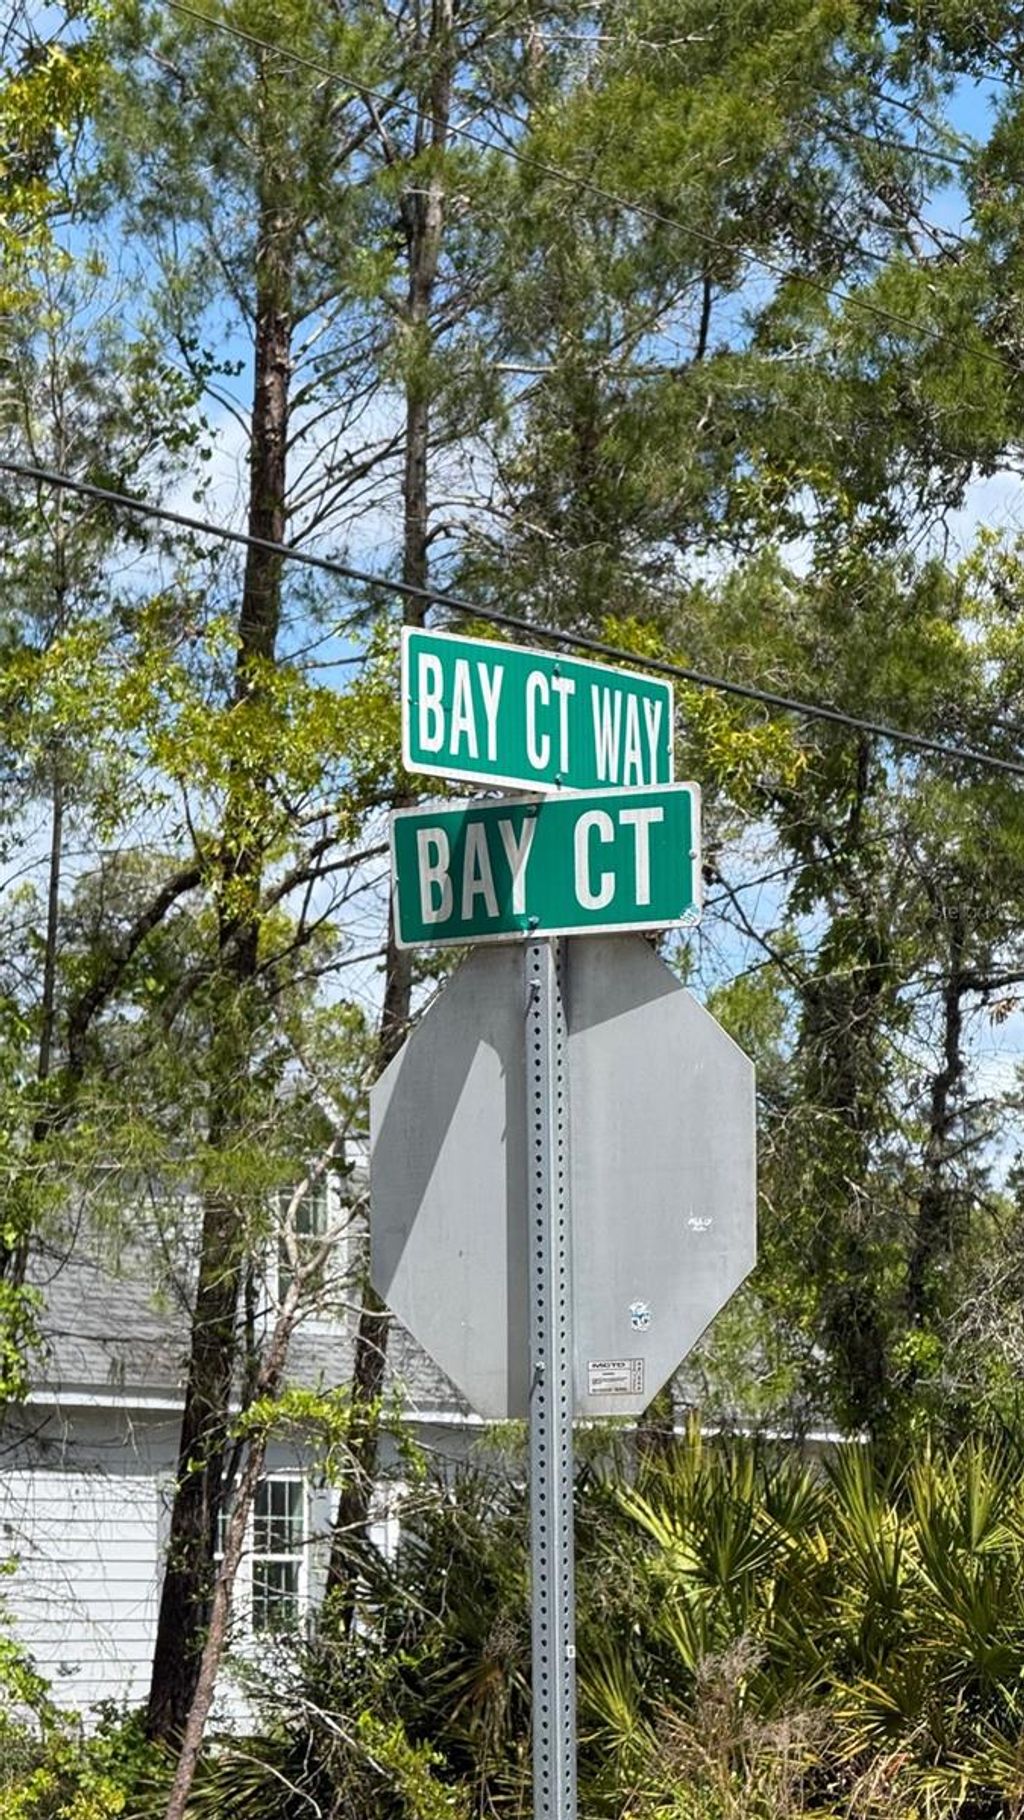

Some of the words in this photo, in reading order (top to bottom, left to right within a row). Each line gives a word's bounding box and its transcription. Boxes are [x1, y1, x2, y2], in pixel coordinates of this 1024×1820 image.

[419, 652, 504, 761] BAY
[526, 670, 575, 773] CT
[591, 684, 662, 786] WAY
[416, 817, 537, 924] BAY
[574, 806, 664, 910] CT
